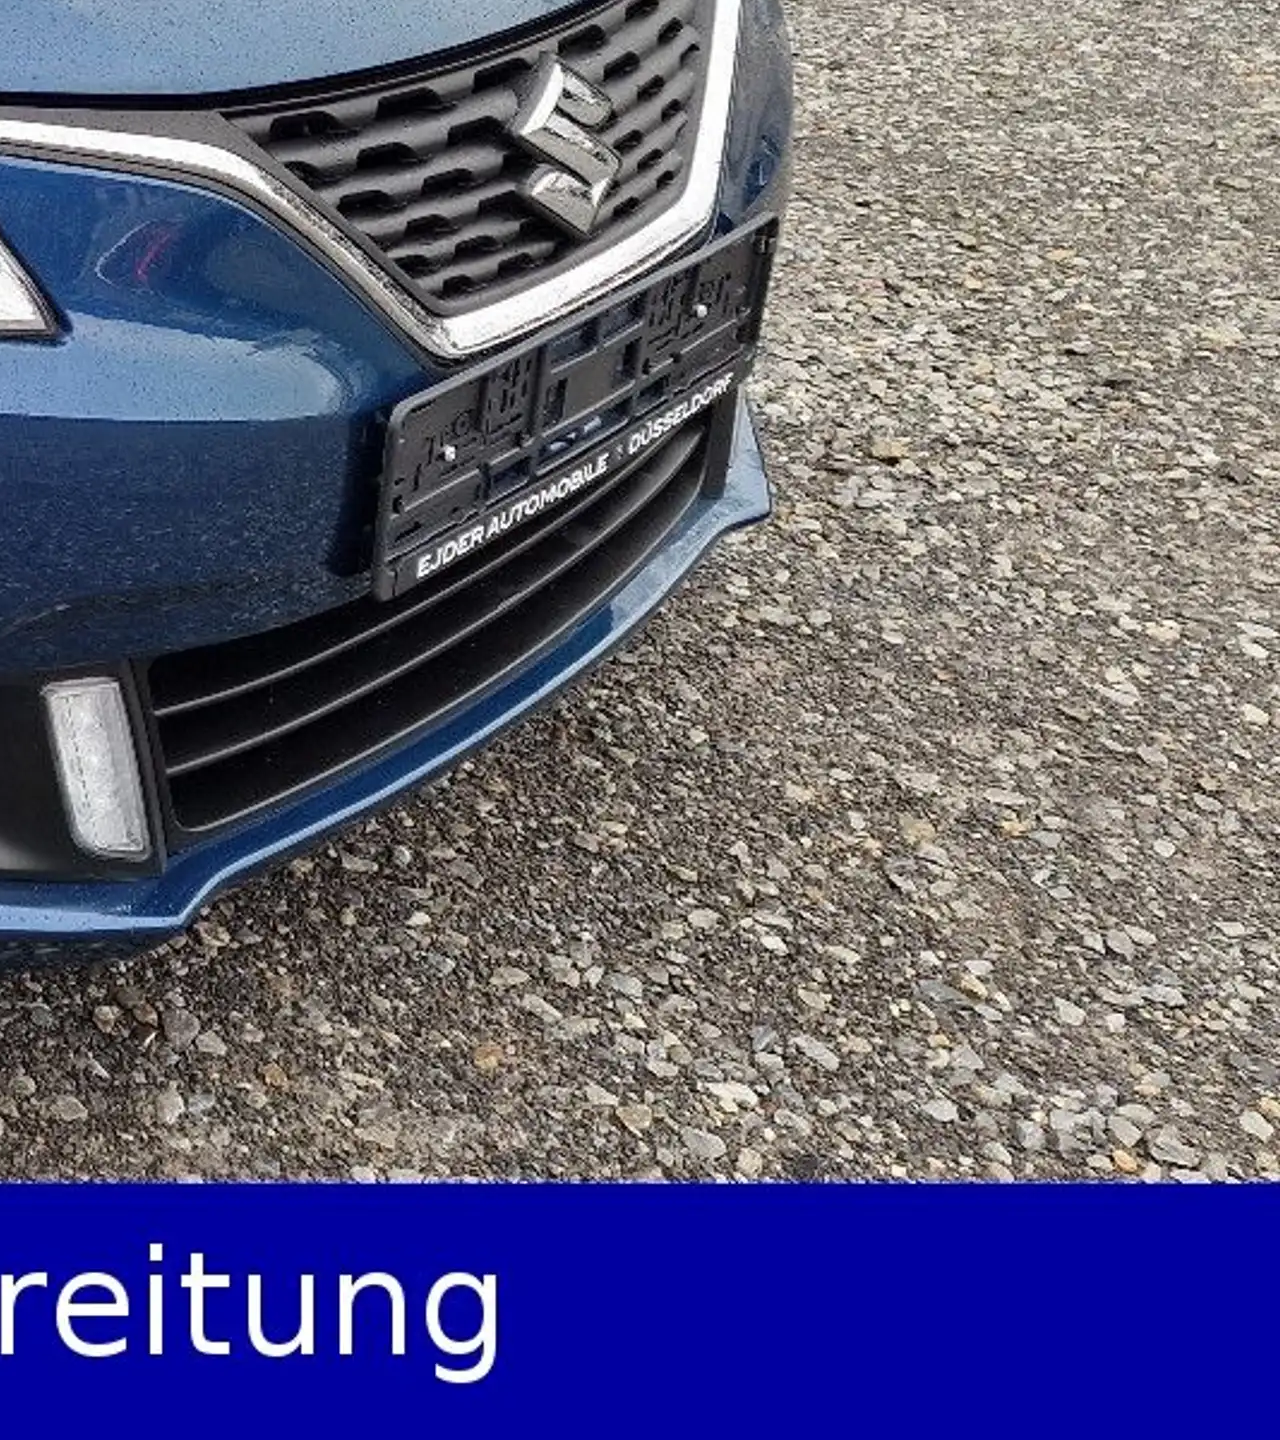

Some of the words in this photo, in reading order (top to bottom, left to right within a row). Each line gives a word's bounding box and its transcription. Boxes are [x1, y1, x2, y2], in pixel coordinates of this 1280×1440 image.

[416, 527, 486, 579] EJDER
[486, 452, 611, 541] AUTOMOBILE
[627, 372, 735, 456] DÜSSELDORF
